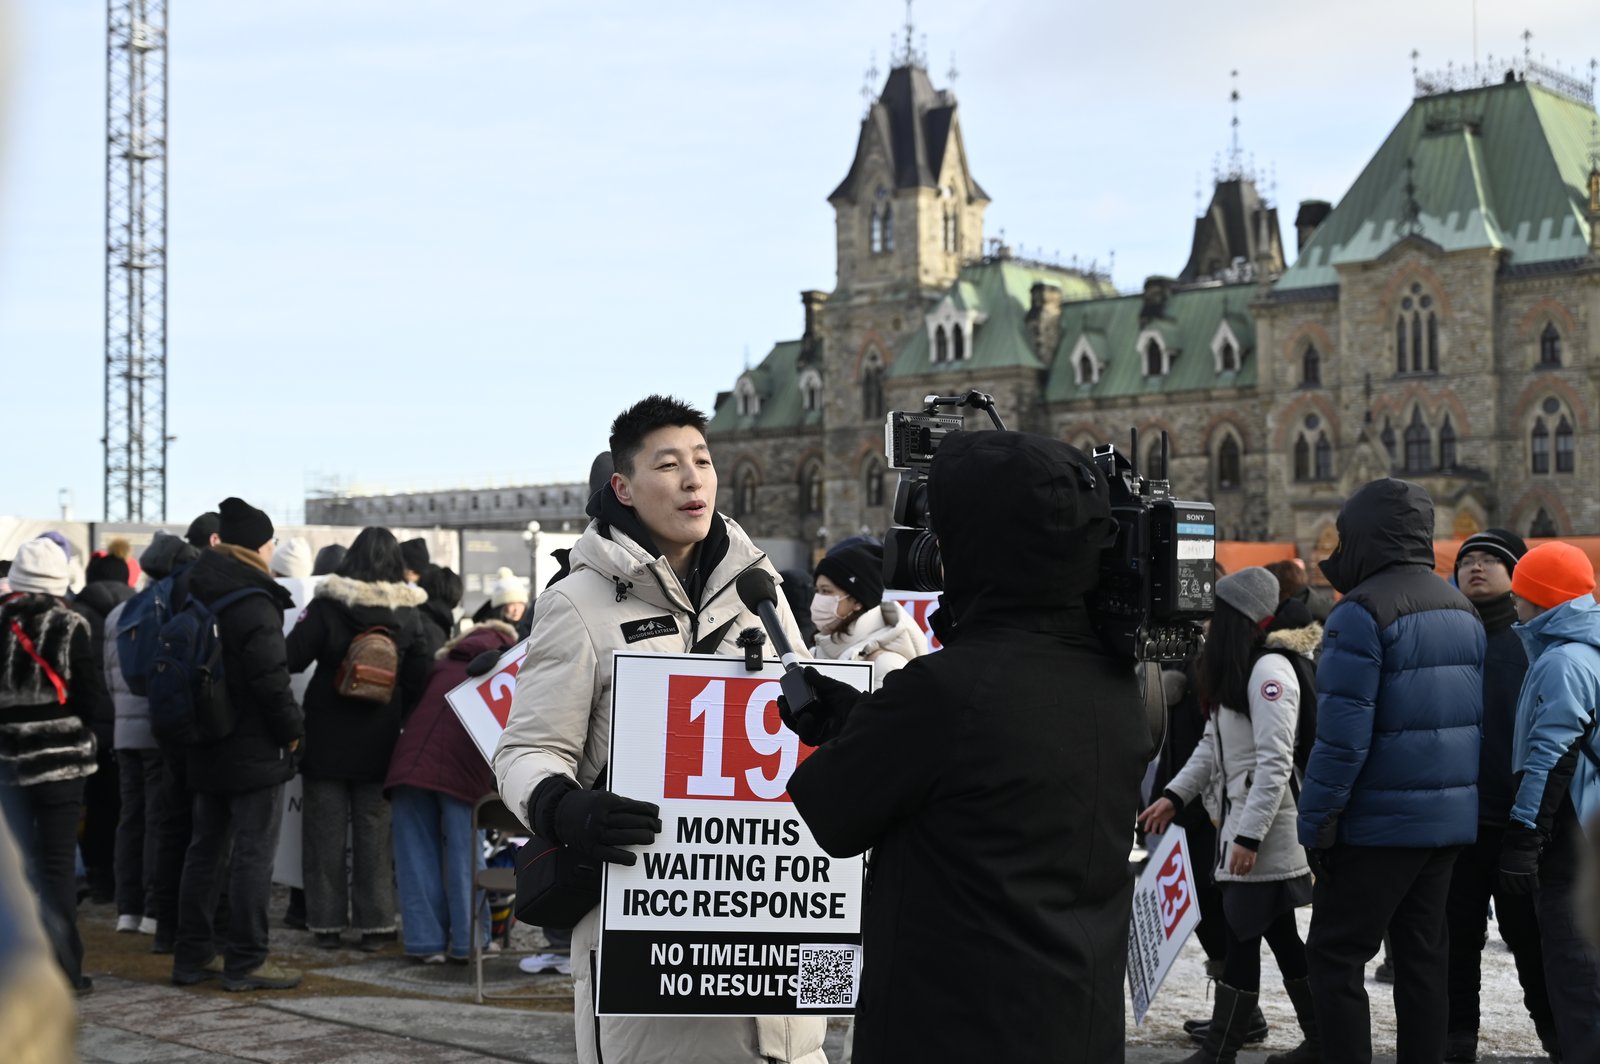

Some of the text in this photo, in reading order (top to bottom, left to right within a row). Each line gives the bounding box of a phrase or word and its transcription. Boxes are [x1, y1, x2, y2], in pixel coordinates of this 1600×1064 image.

[628, 631, 654, 640] BOSIDENG
[686, 680, 799, 799] 19
[676, 817, 800, 846] MONTHS
[643, 853, 830, 883] WAITING FOR
[623, 889, 846, 919] IRCC RESPONSE
[1158, 853, 1188, 929] 23
[1142, 888, 1160, 971] WAITING FOR
[1150, 889, 1164, 946] MONTHS
[651, 943, 799, 967] NO TIMELINE
[660, 973, 799, 997] NO RESULTS
